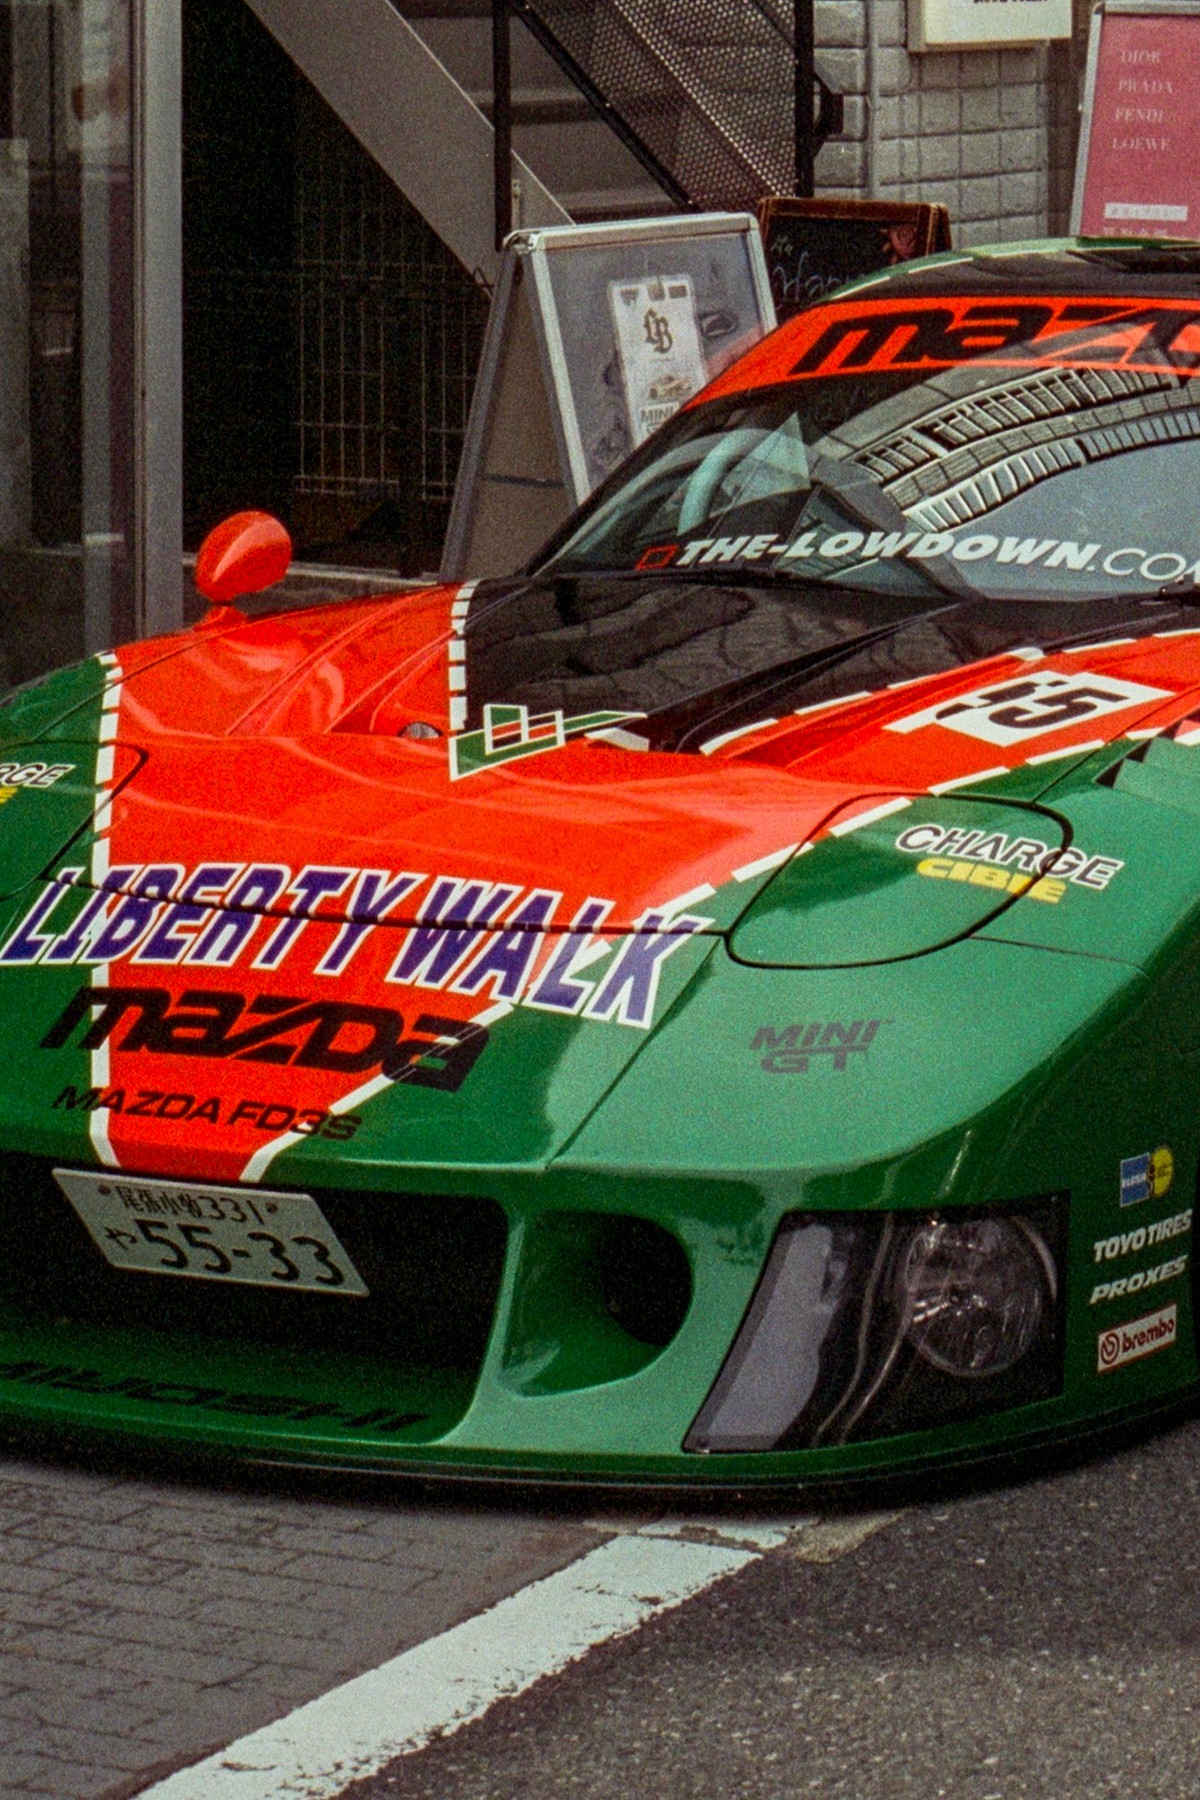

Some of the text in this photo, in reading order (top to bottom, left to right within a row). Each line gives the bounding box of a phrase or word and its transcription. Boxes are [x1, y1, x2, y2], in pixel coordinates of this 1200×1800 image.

[896, 823, 1125, 890] CHARGE
[917, 857, 1066, 904] CIBIE
[0, 863, 714, 1029] LIBERTY WALK
[39, 986, 490, 1093] mazda
[750, 1019, 882, 1050] MINI
[760, 1045, 868, 1075] GT
[51, 1085, 364, 1141] MAZDA FD3S
[104, 1218, 345, 1287] や 55-33
[1094, 1208, 1194, 1263] TOYO TIRES
[1090, 1253, 1188, 1305] PROXES
[1121, 1317, 1175, 1353] brembo
